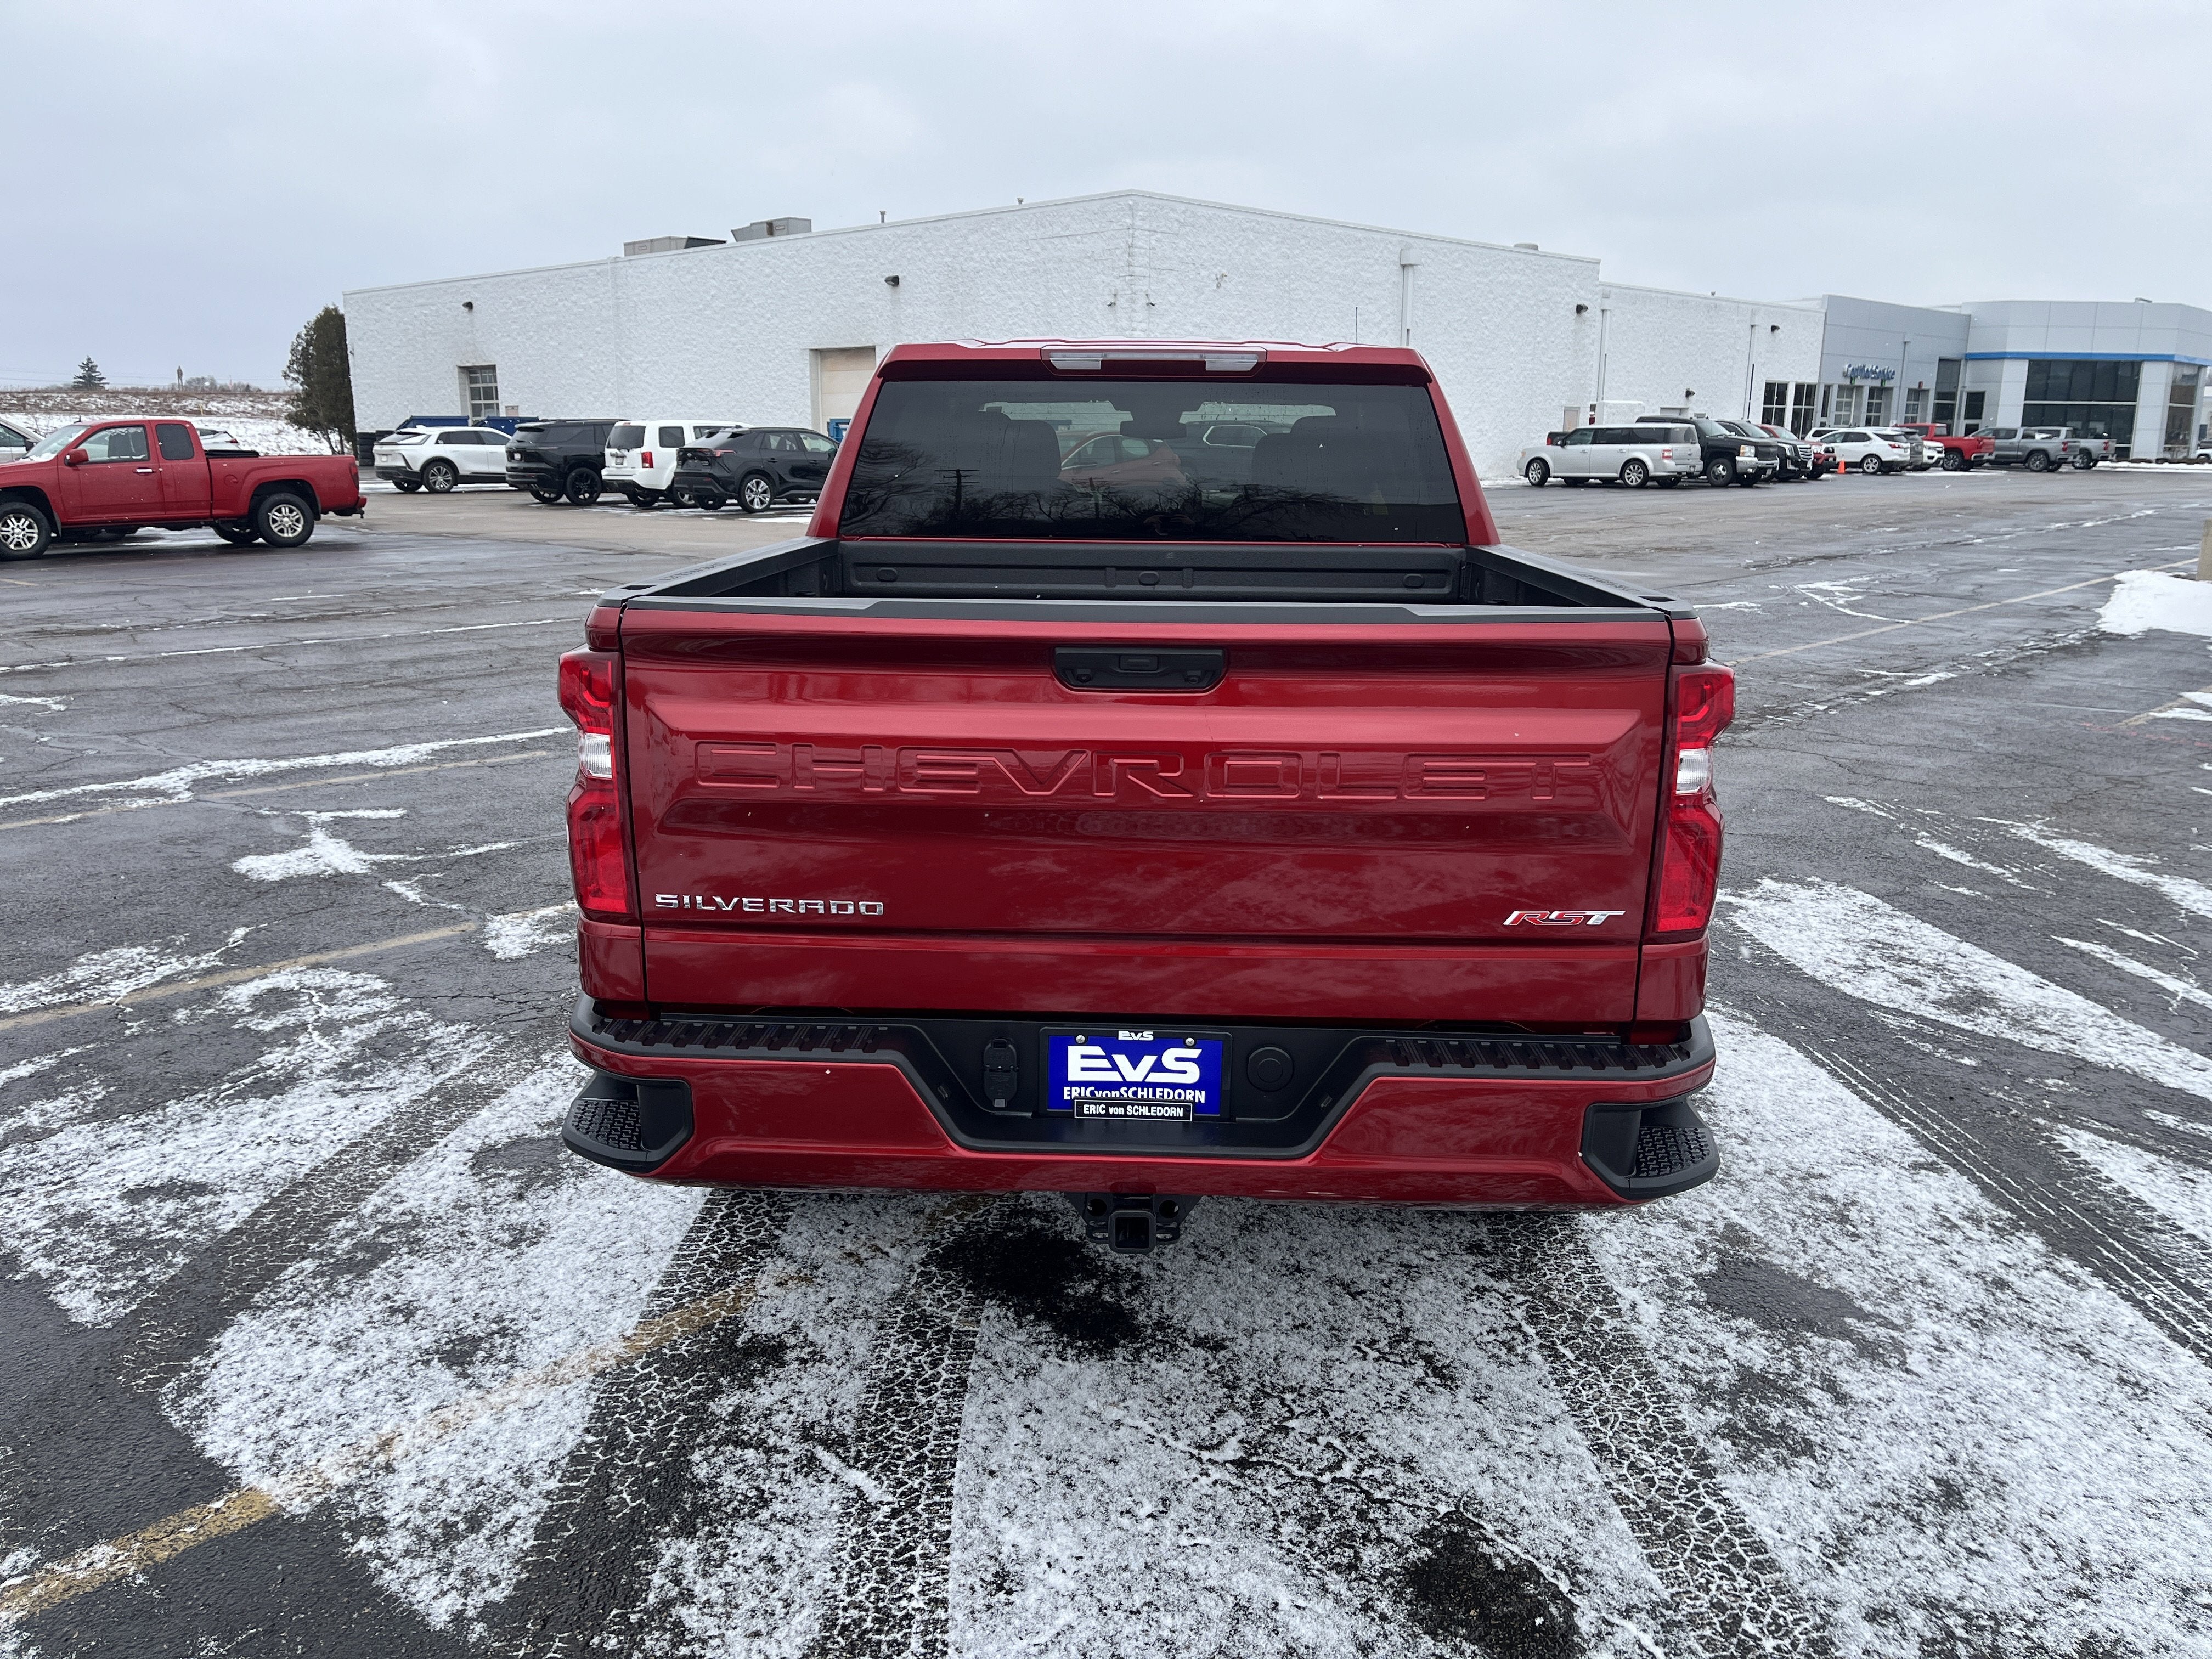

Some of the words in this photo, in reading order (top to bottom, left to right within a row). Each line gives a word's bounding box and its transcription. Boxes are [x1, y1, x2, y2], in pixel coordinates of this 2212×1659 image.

[695, 741, 1592, 800] CHEVROLET
[656, 893, 884, 916] SILVERADO
[1503, 911, 1626, 926] RST
[1084, 1104, 1106, 1115] ERIC
[1109, 1106, 1124, 1115] von
[1126, 1105, 1183, 1118] SCHLEDORN
